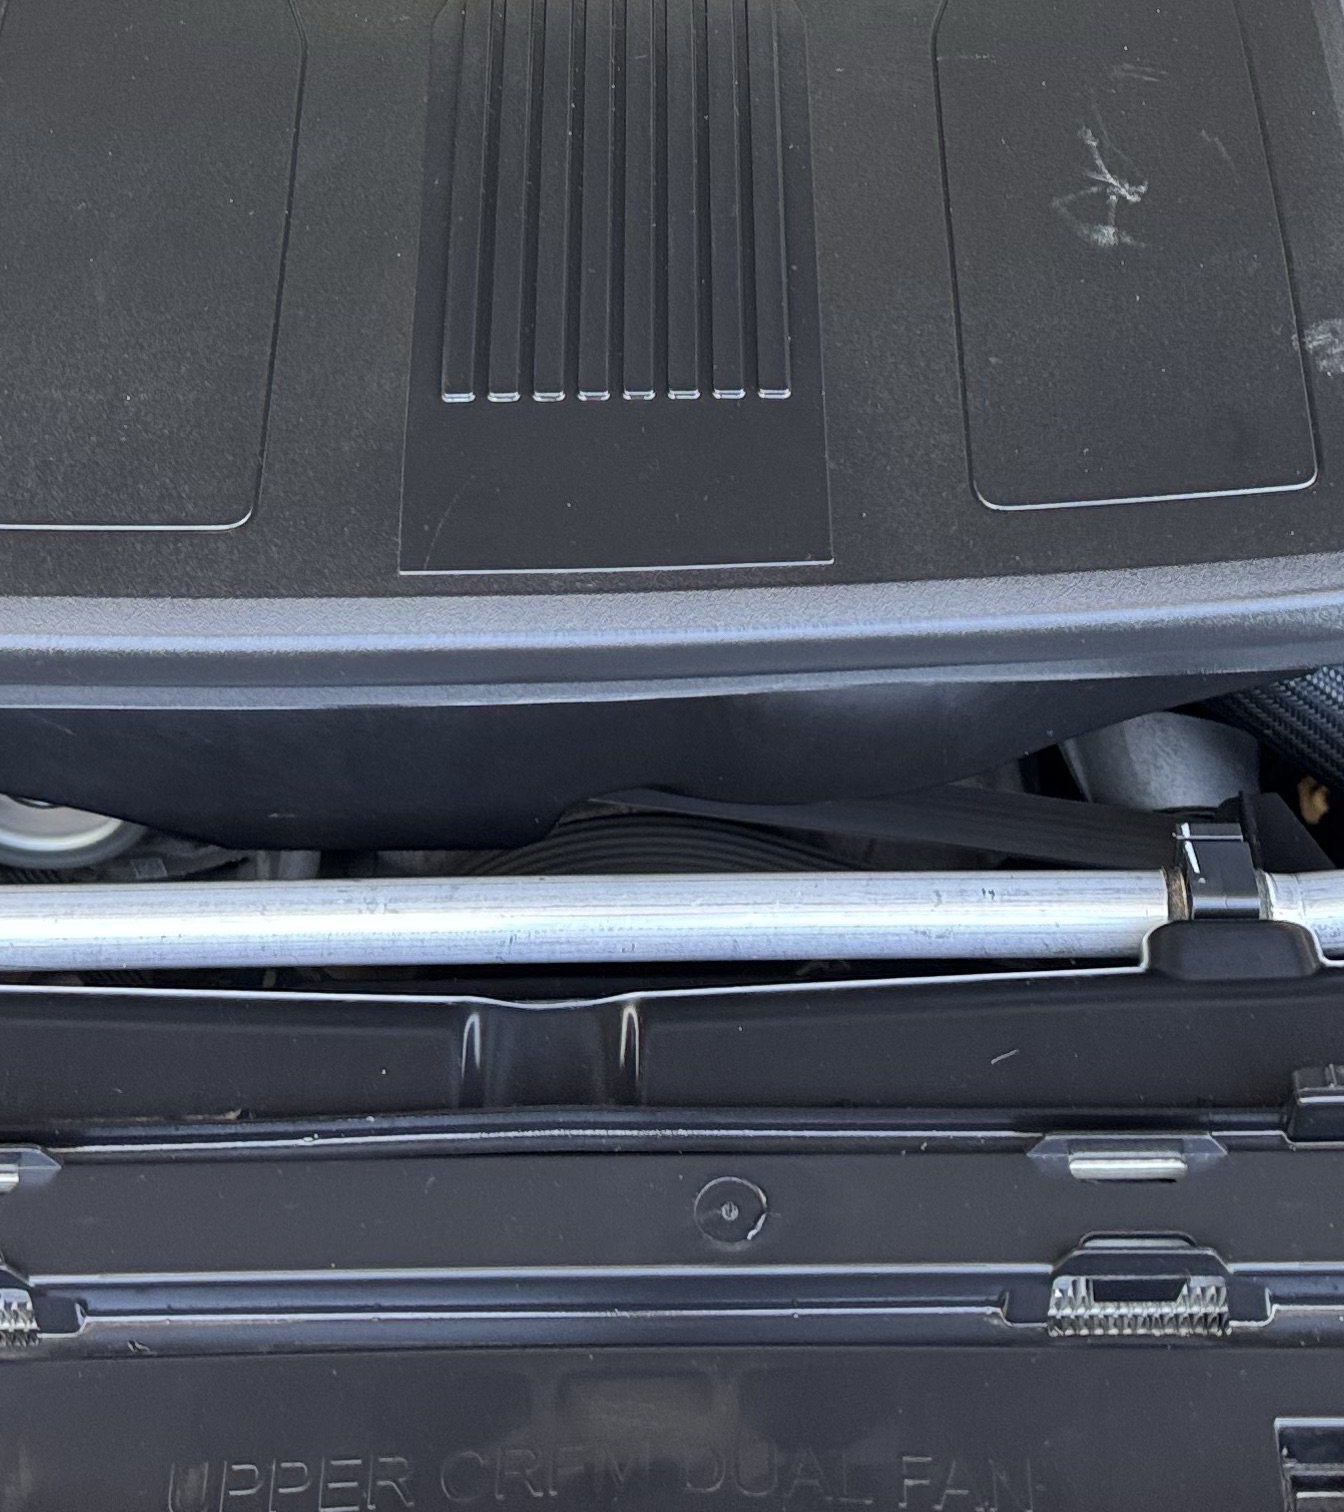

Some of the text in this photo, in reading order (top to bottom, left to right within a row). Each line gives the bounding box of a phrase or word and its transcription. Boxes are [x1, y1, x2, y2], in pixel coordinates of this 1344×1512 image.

[167, 1455, 416, 1512] UPPER
[684, 1438, 875, 1506] DUAL
[897, 1455, 1034, 1512] FAN
